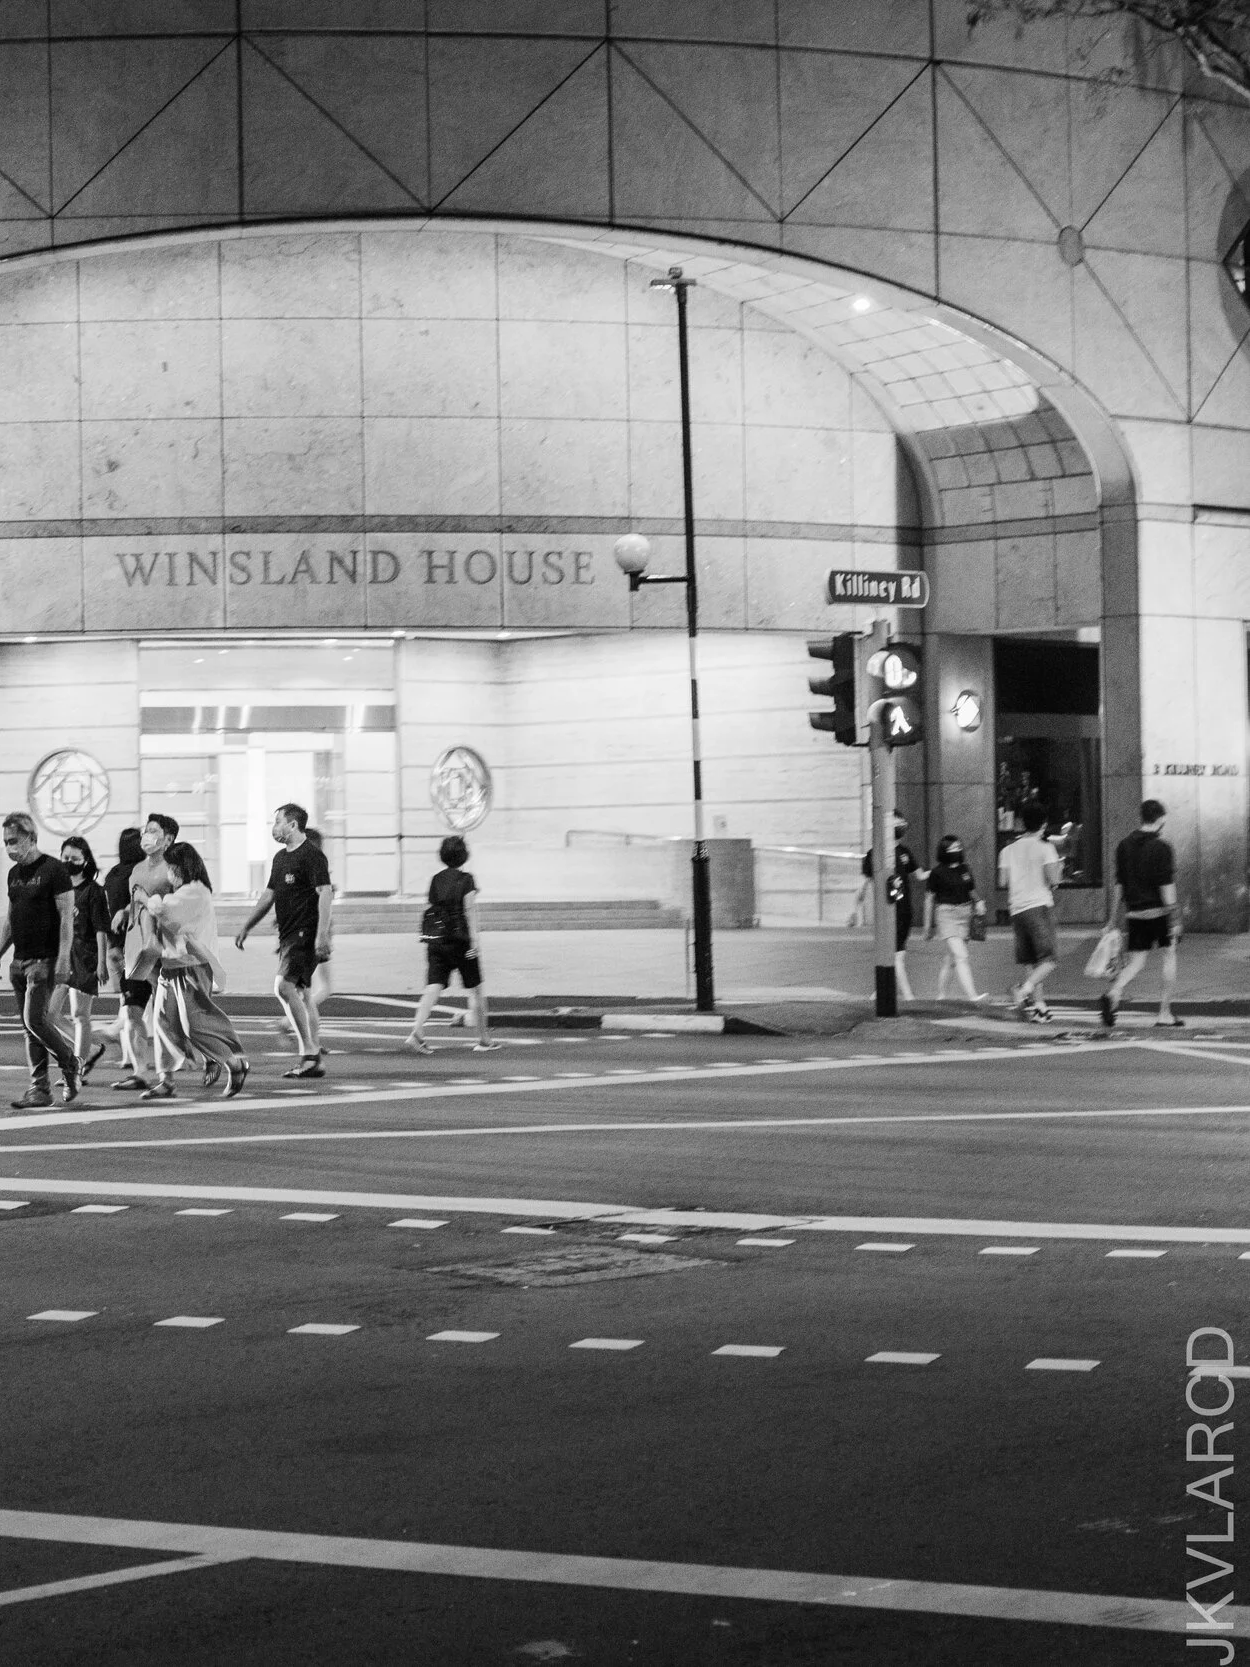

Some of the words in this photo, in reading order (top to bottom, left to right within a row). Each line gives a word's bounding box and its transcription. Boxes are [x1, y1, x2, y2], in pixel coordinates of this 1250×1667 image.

[116, 549, 402, 588] WINSLAND
[421, 548, 596, 587] HOUSE
[834, 572, 897, 603] Killiney
[900, 575, 921, 599] Rd
